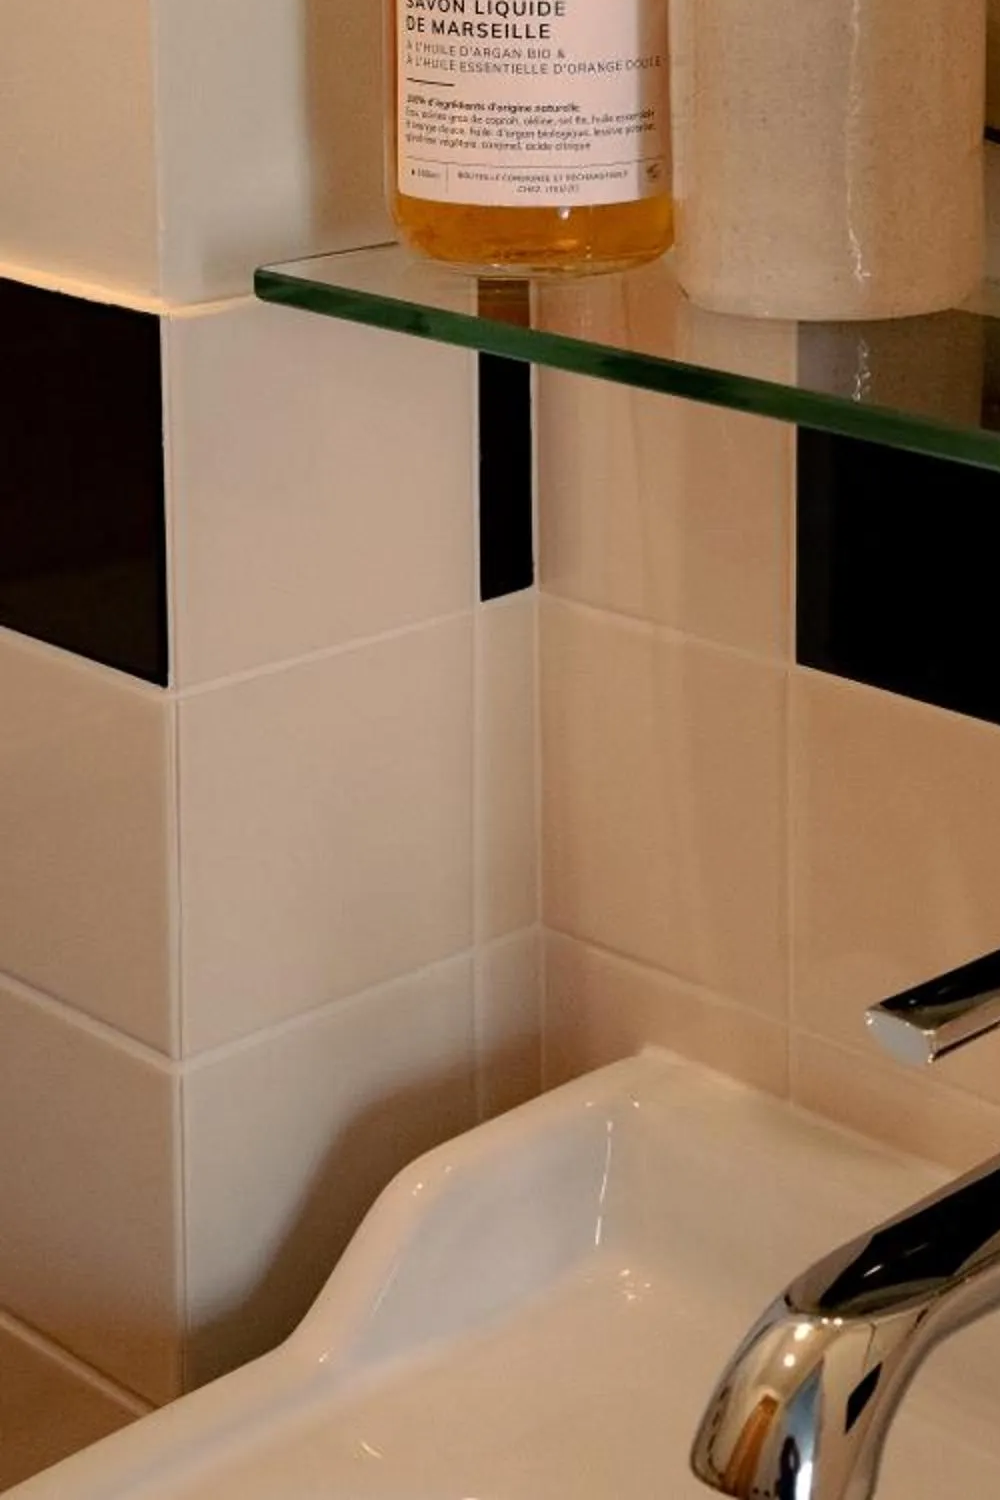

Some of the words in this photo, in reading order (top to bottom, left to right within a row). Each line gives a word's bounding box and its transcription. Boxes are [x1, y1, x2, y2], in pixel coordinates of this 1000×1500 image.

[406, 15, 425, 32] DE
[431, 19, 551, 39] MARSEILLE
[459, 45, 521, 59] D'ARGAN
[527, 48, 551, 59] BIO
[459, 60, 549, 75] ESSENTIELLE
[553, 60, 623, 75] D'ORANGE
